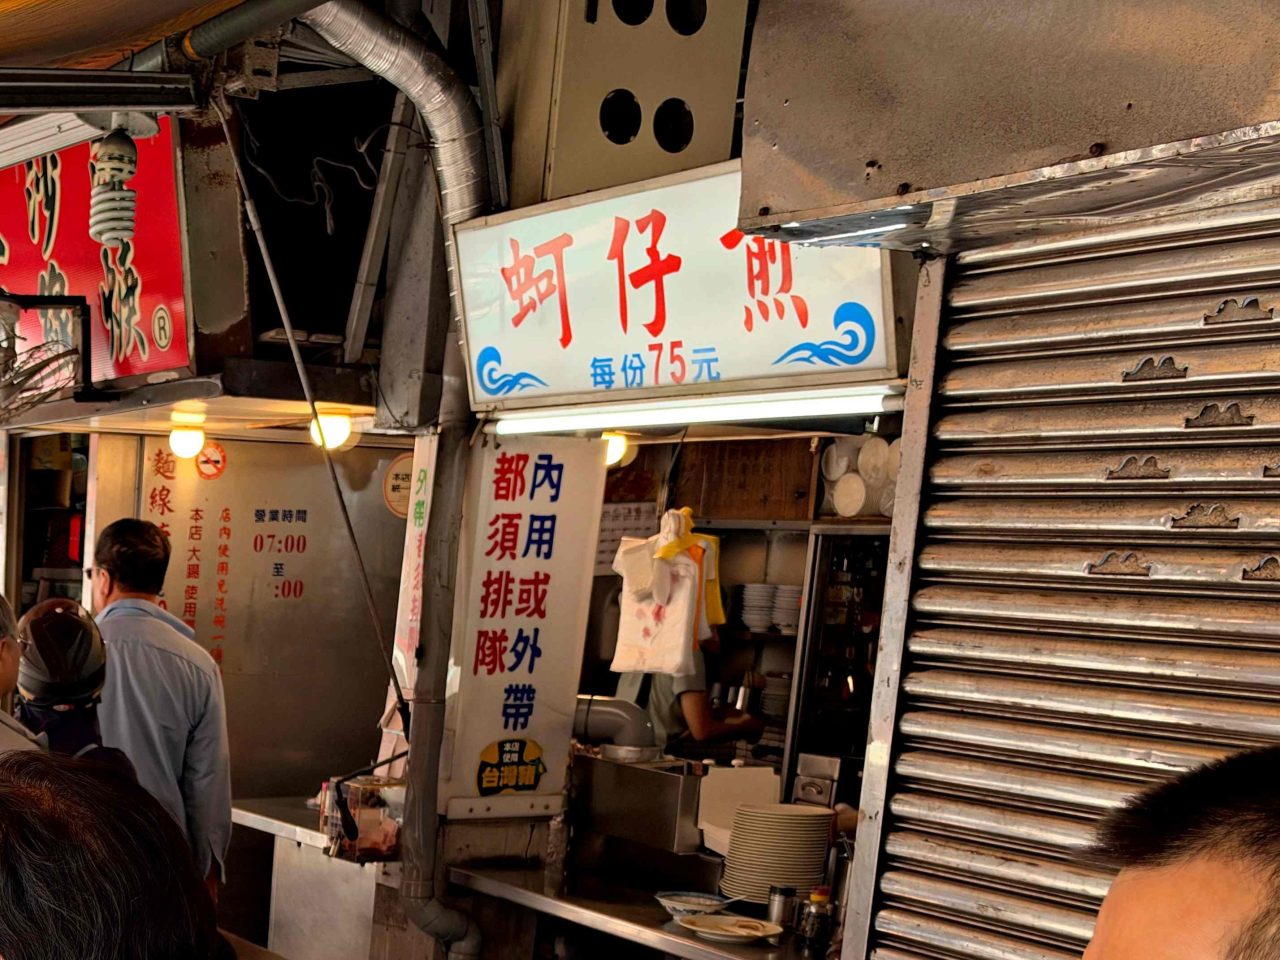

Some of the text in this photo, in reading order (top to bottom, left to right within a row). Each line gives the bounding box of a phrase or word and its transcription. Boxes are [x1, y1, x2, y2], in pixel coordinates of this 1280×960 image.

[500, 208, 809, 349] 蚵仔煎
[590, 340, 721, 390] 每份75元
[254, 508, 308, 524] 營業時間
[253, 533, 307, 554] 07:00
[473, 452, 530, 676] 都須排隊
[272, 562, 285, 578] 至
[502, 453, 564, 731] 內用或外帶
